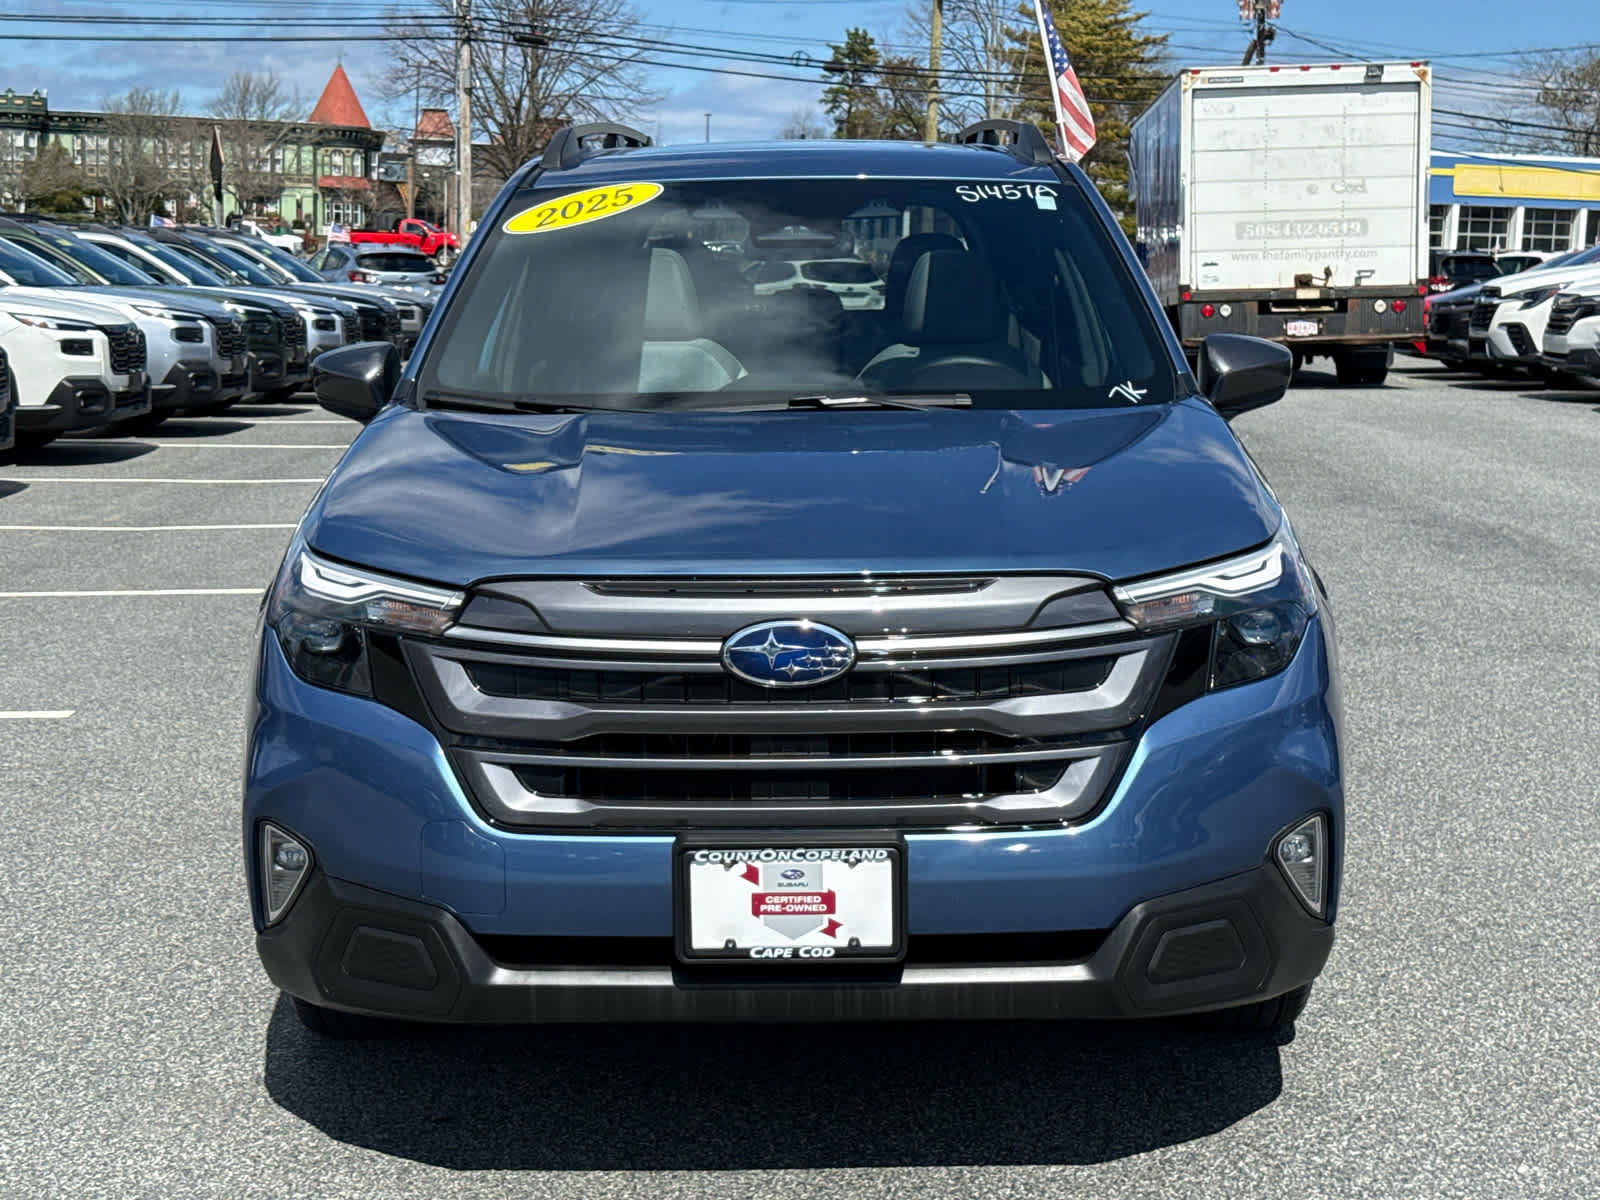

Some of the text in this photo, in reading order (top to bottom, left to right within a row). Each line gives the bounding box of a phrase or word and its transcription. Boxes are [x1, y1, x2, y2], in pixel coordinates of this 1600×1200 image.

[535, 187, 634, 228] 2025
[760, 904, 827, 912] PRE-OWNED
[750, 946, 835, 958] CAPE COD
